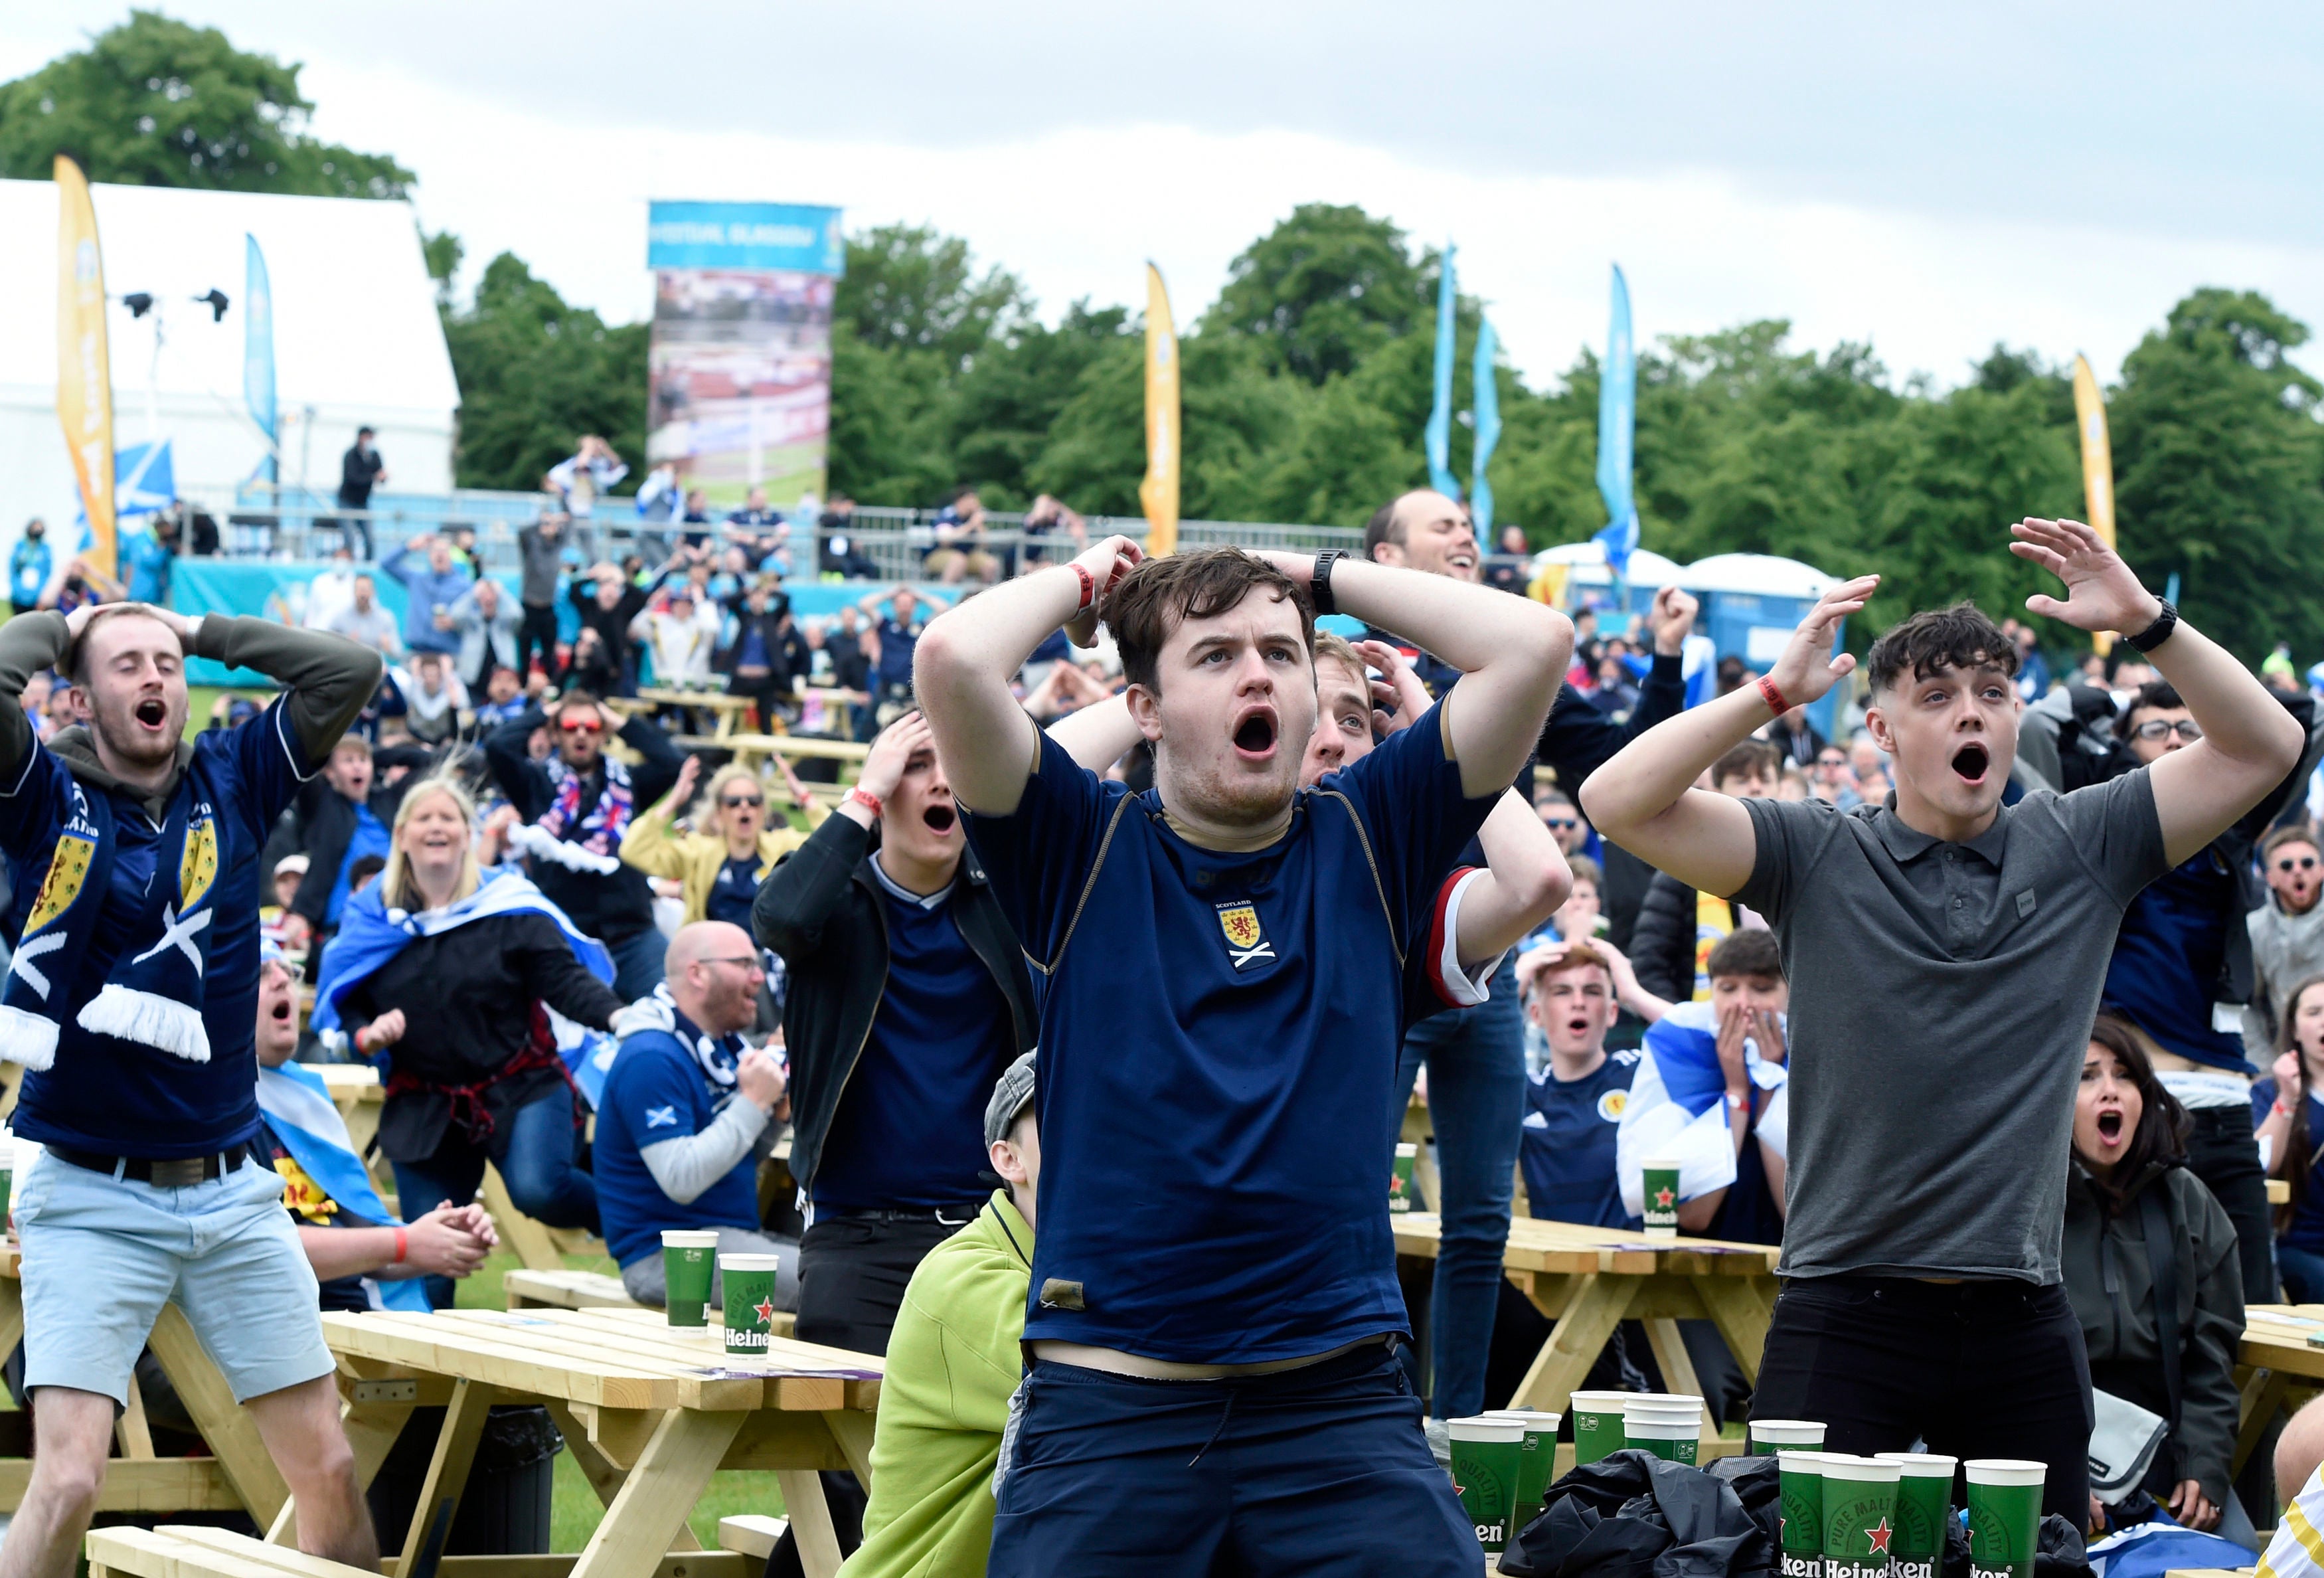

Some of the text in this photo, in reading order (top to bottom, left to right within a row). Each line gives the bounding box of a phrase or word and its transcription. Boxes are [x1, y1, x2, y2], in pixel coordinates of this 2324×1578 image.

[1760, 676, 1779, 701] Gard
[64, 816, 99, 837] AND
[1215, 900, 1251, 909] SCOTLAND
[725, 1328, 771, 1347] Heine
[1831, 1496, 1892, 1547] PURE MALT
[1474, 1524, 1503, 1542] en
[1781, 1552, 1822, 1578] ken
[1825, 1559, 1888, 1578] Heine
[1888, 1555, 1933, 1578] ken
